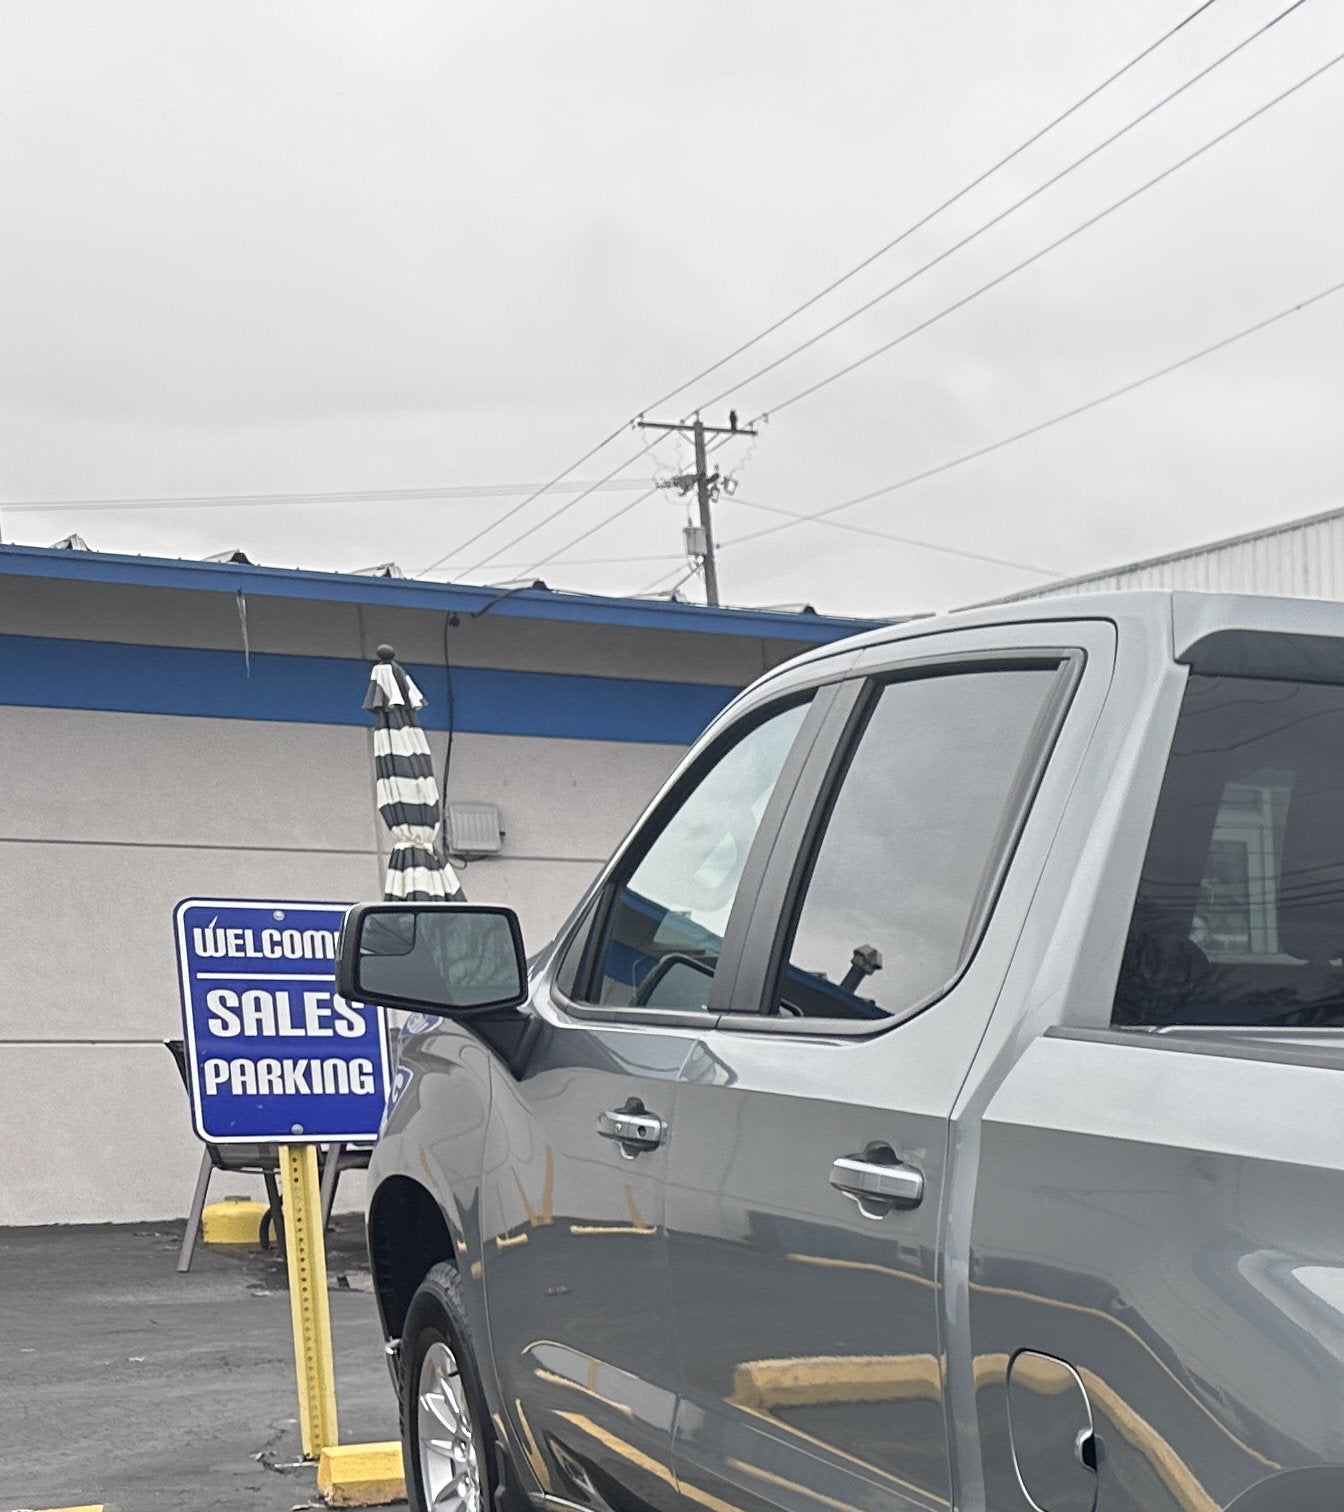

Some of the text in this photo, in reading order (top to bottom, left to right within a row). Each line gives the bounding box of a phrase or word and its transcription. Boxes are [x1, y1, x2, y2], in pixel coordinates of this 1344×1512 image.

[193, 927, 341, 960] WELCOM
[206, 989, 366, 1038] SALES
[204, 1058, 375, 1096] PARKING
